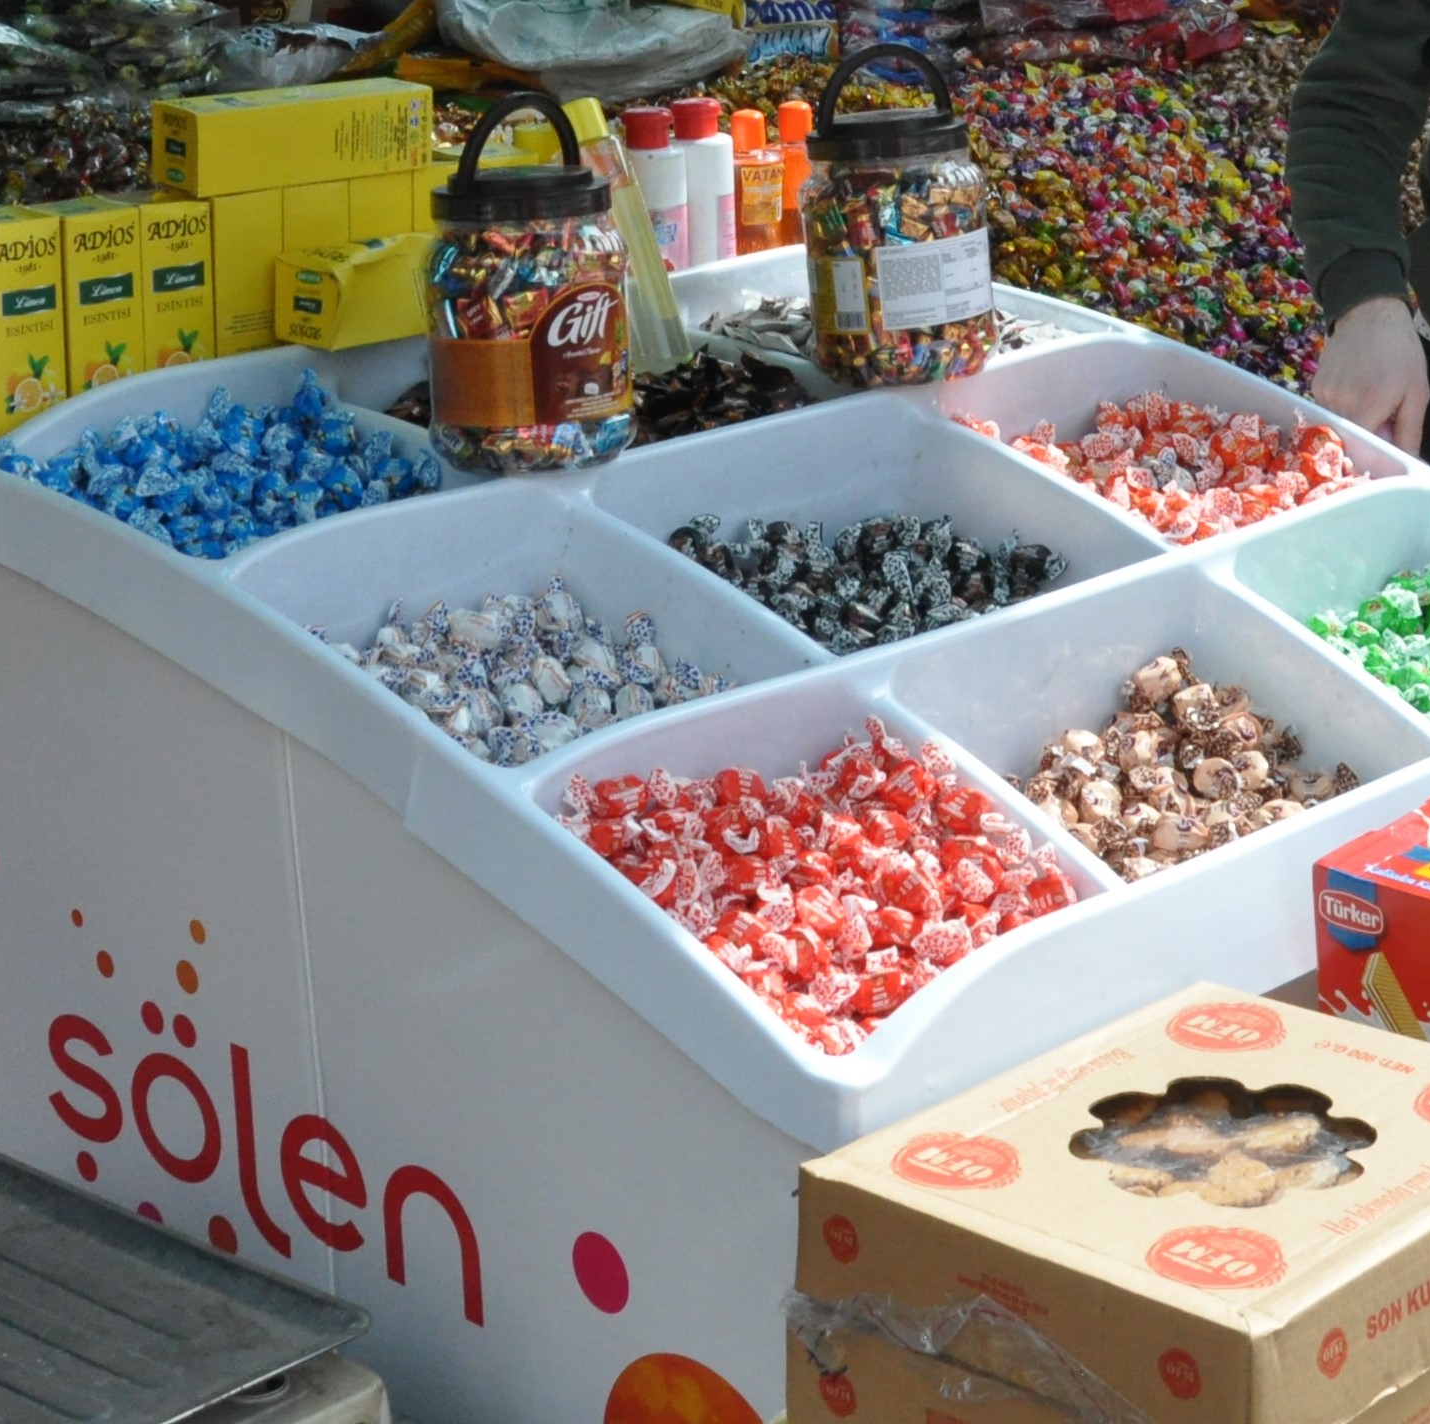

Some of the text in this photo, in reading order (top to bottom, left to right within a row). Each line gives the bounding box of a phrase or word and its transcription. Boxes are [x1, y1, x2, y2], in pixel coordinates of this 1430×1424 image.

[743, 167, 783, 182] VATAN
[74, 223, 135, 252] ADİOS
[147, 213, 208, 241] ADİOS
[547, 291, 619, 347] Gift
[1323, 896, 1381, 929] Türker
[1347, 1049, 1374, 1064] 900
[1379, 1058, 1416, 1074] NET:
[1365, 1299, 1403, 1340] SON
